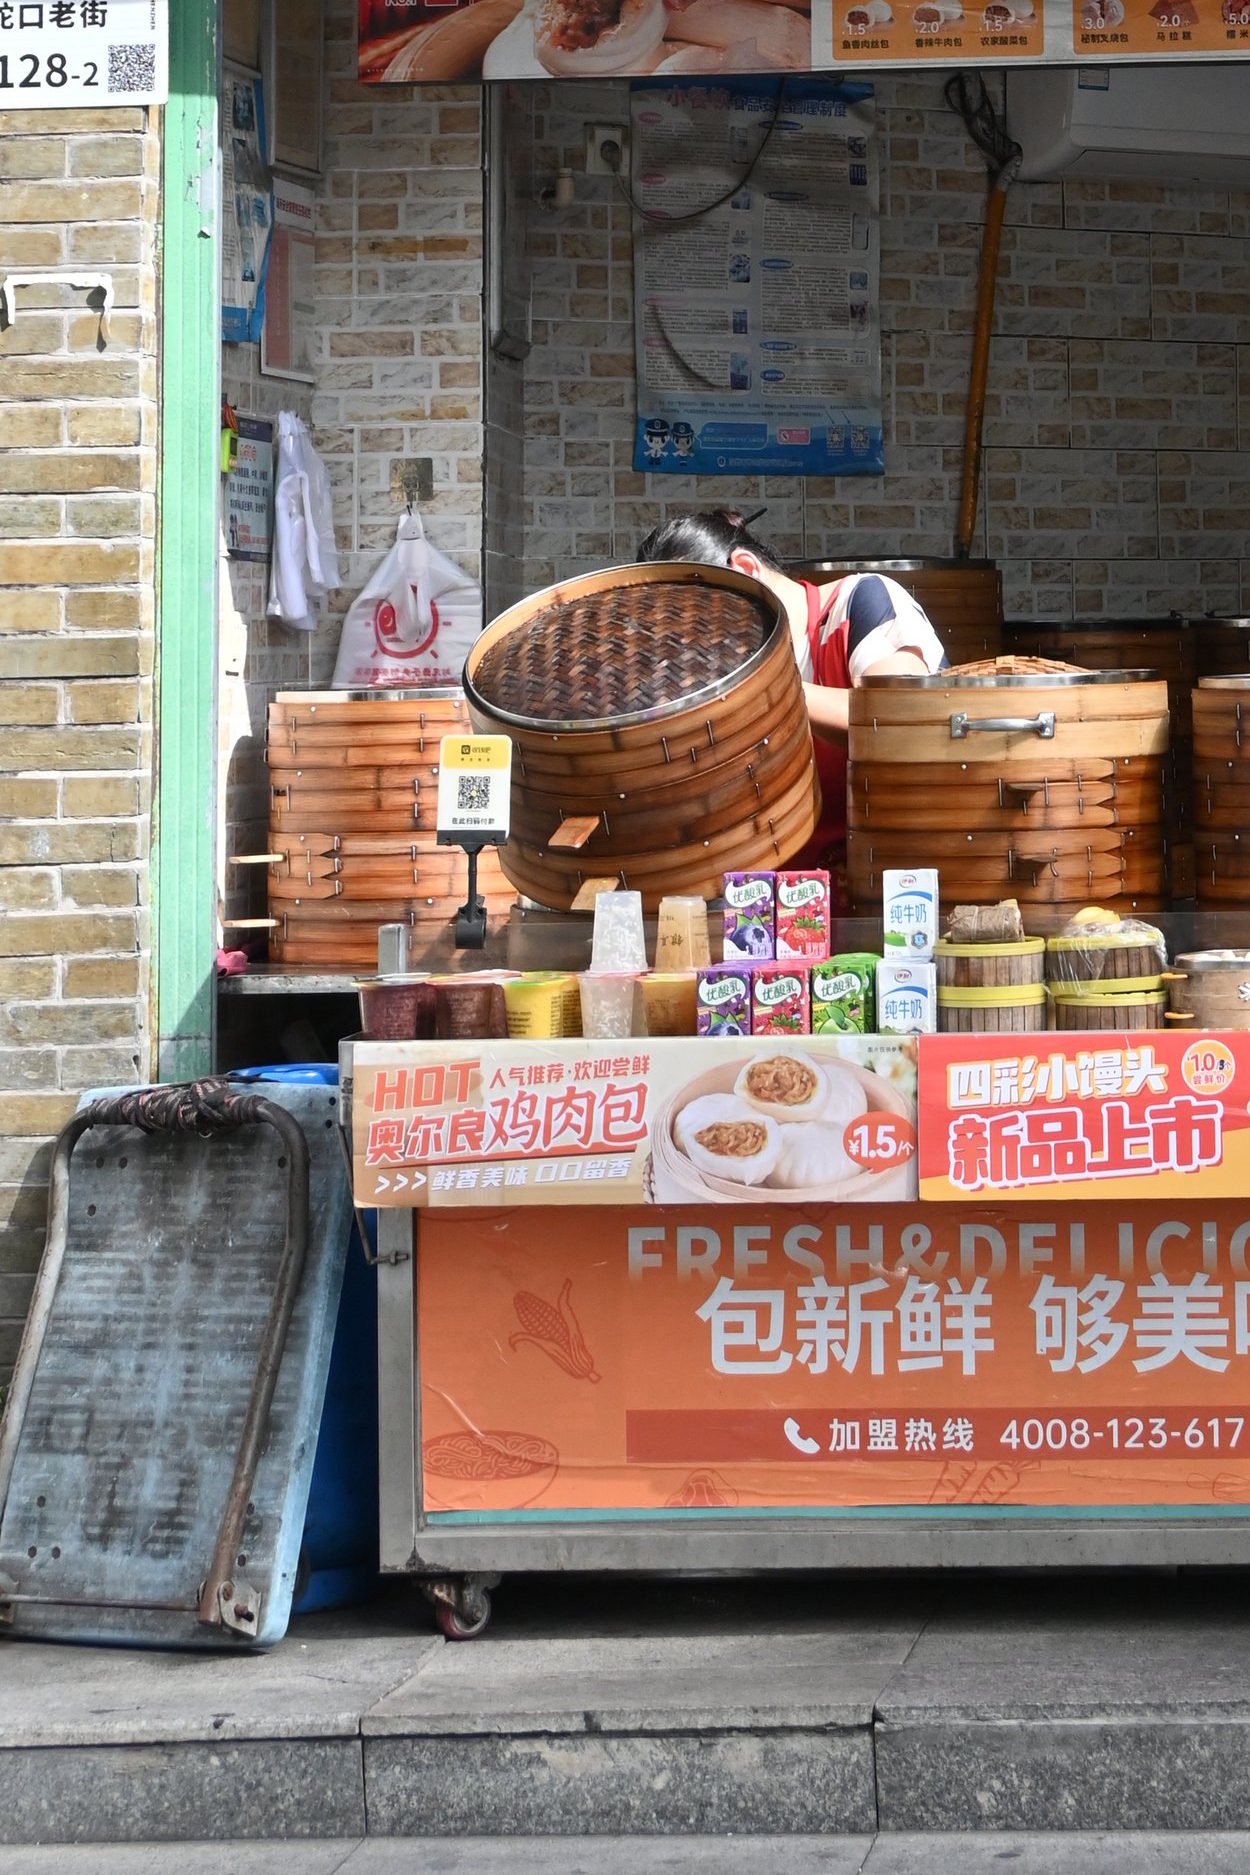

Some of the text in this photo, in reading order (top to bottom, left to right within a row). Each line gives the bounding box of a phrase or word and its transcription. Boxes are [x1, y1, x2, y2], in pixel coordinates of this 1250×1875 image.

[451, 817, 495, 826] 在此扫码付款
[733, 885, 767, 904] 优酸乳
[786, 885, 820, 904] 优酸乳
[889, 903, 927, 924] 纯牛奶
[706, 983, 741, 1002] 优酸乳
[762, 983, 797, 1002] 优酸乳
[821, 979, 856, 998] 优酸乳
[884, 998, 923, 1020] 纯牛奶
[372, 1060, 481, 1113] HOT
[949, 1047, 1168, 1109] 四彩小馒头
[1192, 1073, 1226, 1087] 尝鲜价
[365, 1081, 650, 1166] 奥尔良鸡肉包
[949, 1096, 1224, 1191] 新品上市
[430, 1156, 633, 1192] 鲜香美味 口口留香
[695, 1275, 996, 1377] 包新鲜
[828, 1416, 1245, 1453] 加盟热线 4008-123-617
